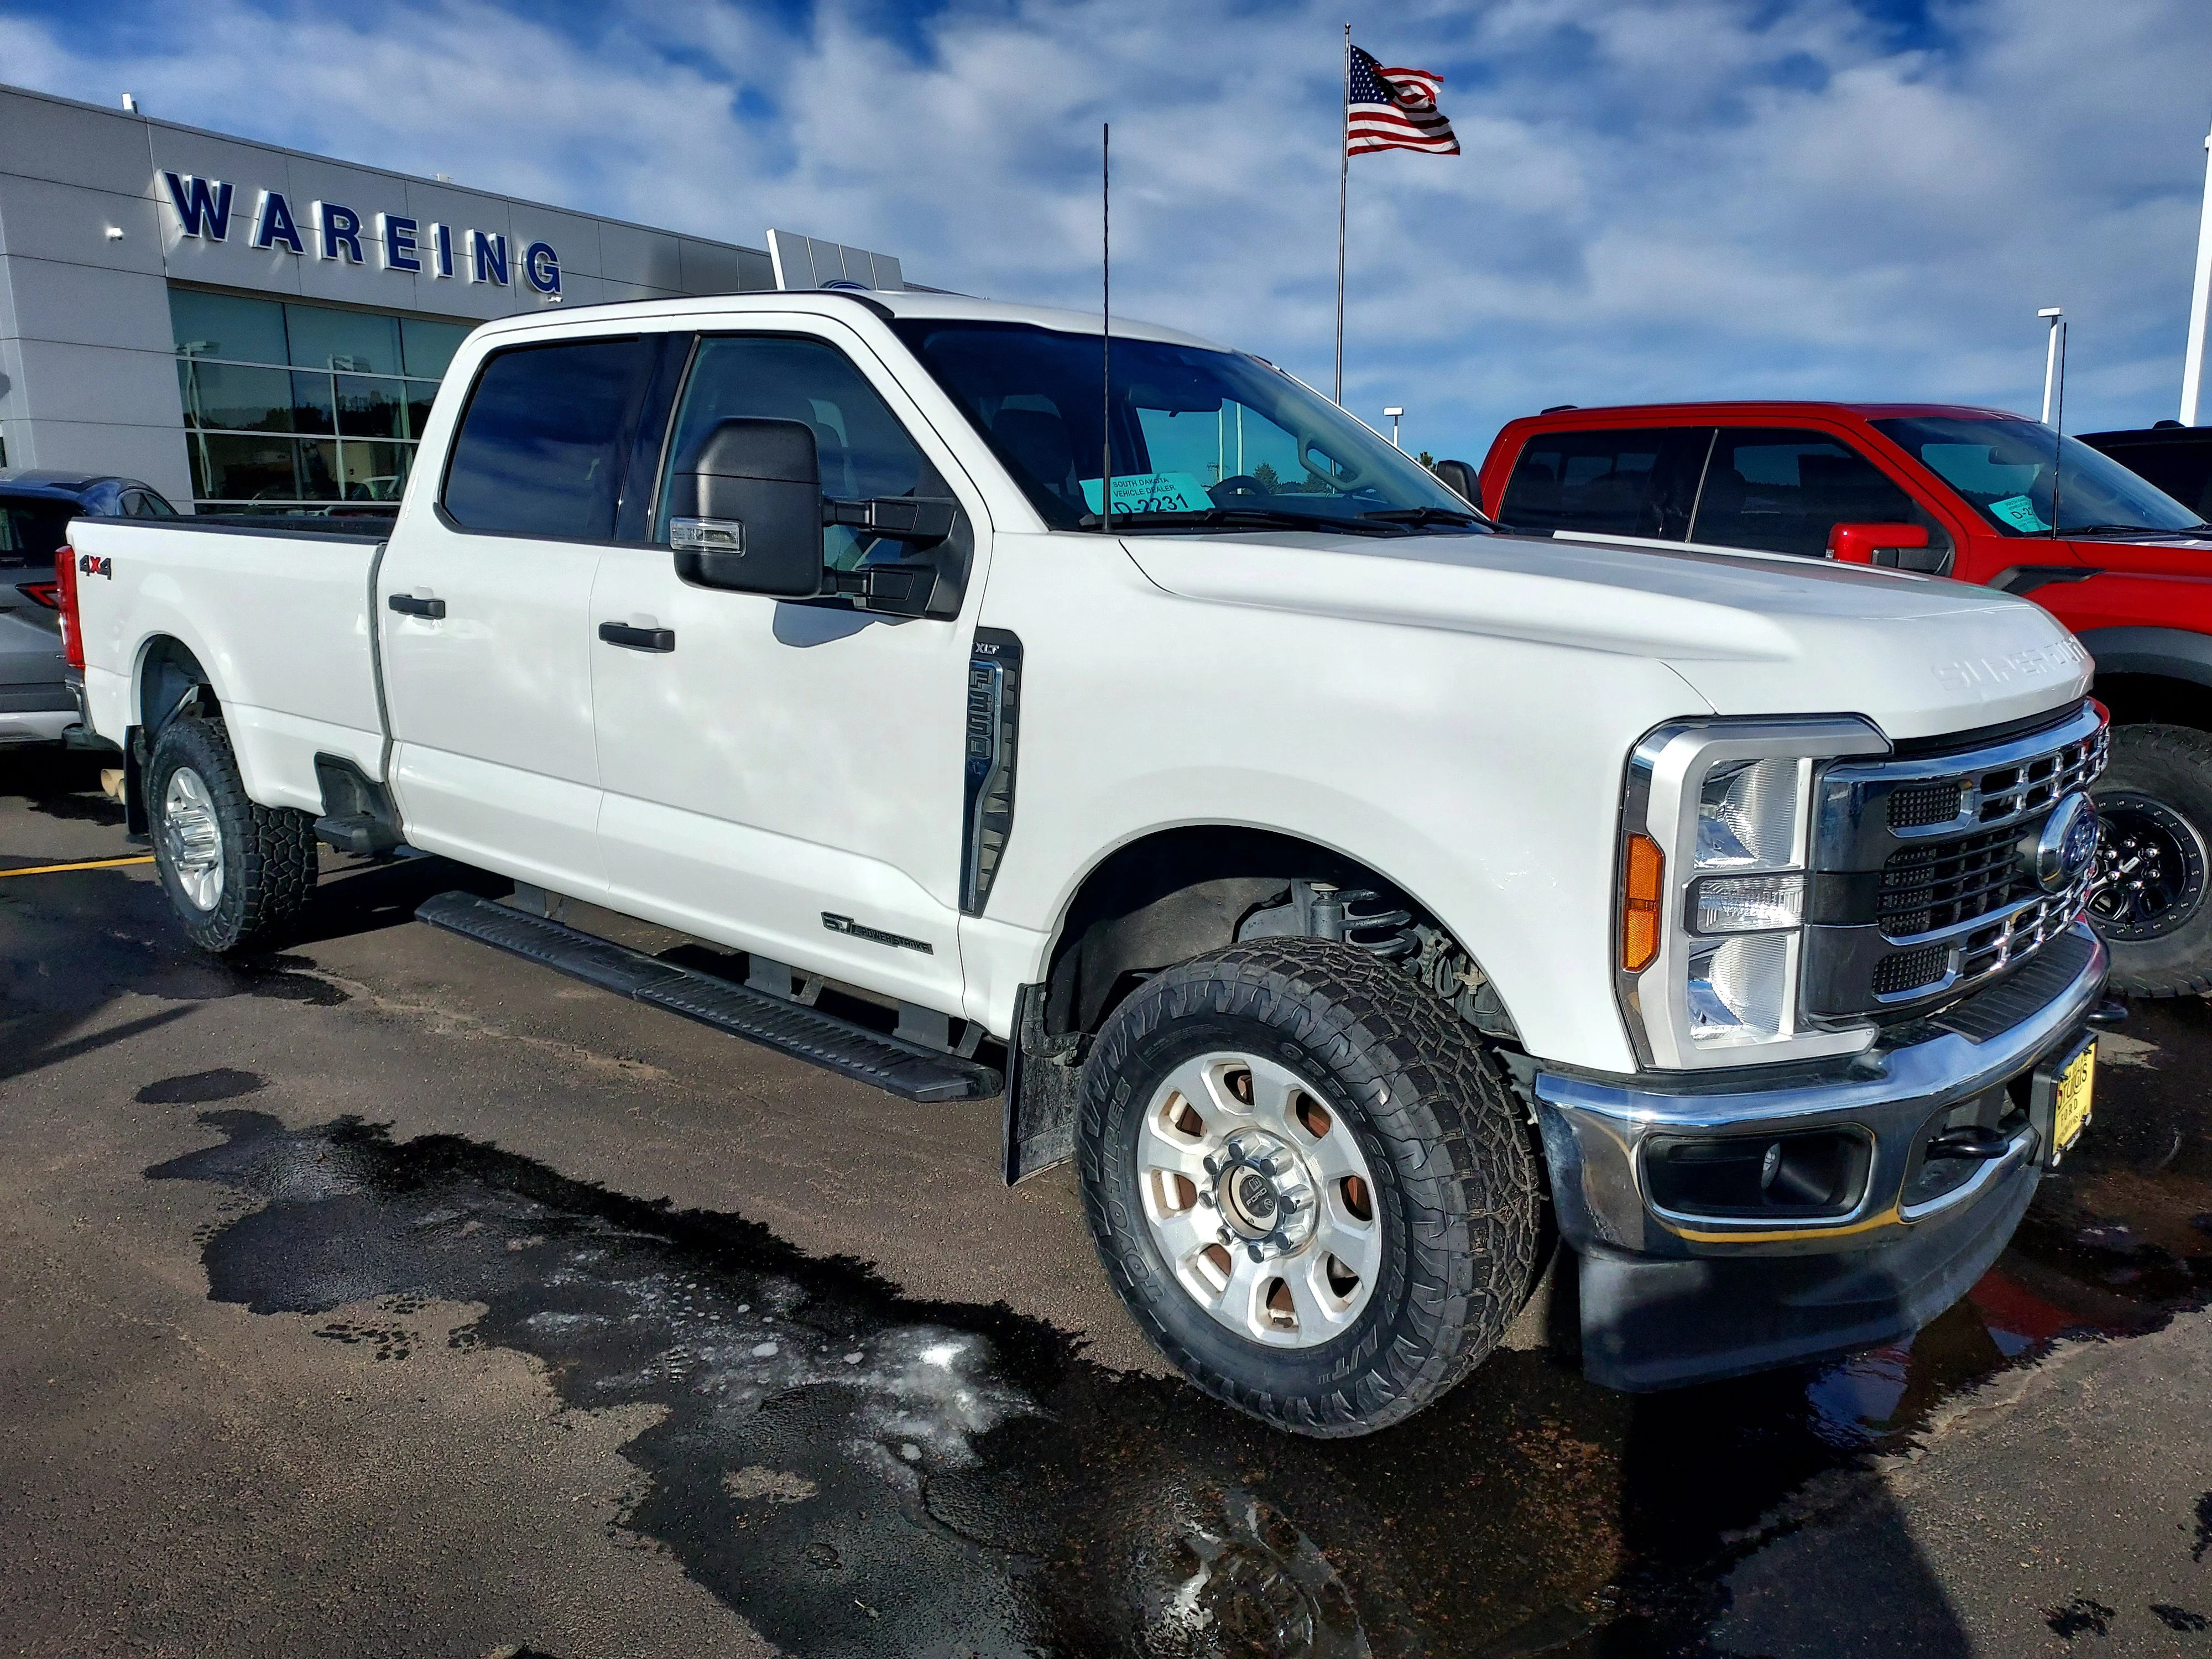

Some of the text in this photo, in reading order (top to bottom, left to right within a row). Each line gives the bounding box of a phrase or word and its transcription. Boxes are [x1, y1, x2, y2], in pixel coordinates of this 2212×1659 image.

[163, 169, 563, 294] WAREING
[1113, 484, 1176, 497] VEHICLE DEALER
[1113, 493, 1188, 513] D-2231
[975, 641, 999, 655] XLT
[2061, 1098, 2078, 1126] FORD
[1103, 1076, 1165, 1304] TOYO TIRES
[1246, 1187, 1267, 1206] FORD
[1280, 1042, 1366, 1122] OPEN
[1363, 1135, 1406, 1327] COUNTRY
